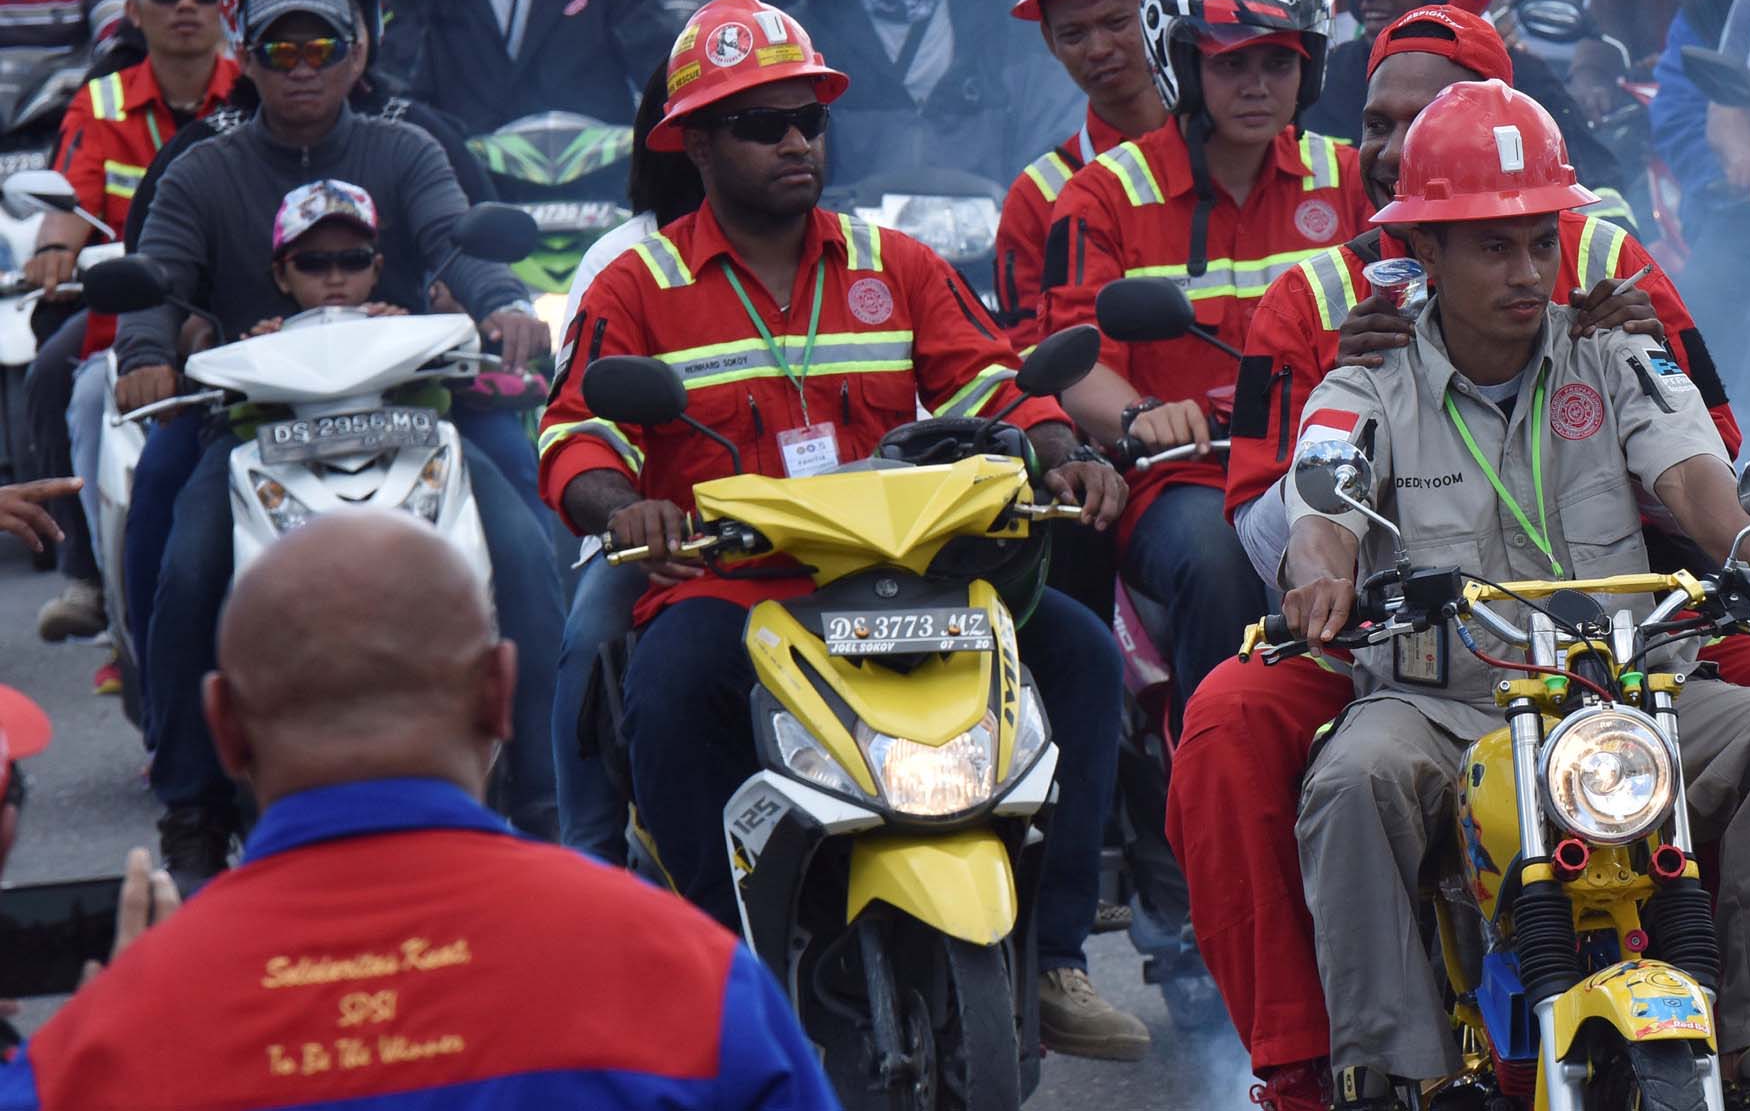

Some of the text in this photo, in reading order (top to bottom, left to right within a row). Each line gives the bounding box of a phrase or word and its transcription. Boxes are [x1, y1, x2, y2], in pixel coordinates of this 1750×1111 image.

[1424, 472, 1464, 488] YOOM
[874, 615, 935, 639] 3773
[831, 640, 858, 653] JOEL
[940, 639, 955, 650] 07
[974, 638, 990, 649] 20
[733, 795, 782, 835] 125
